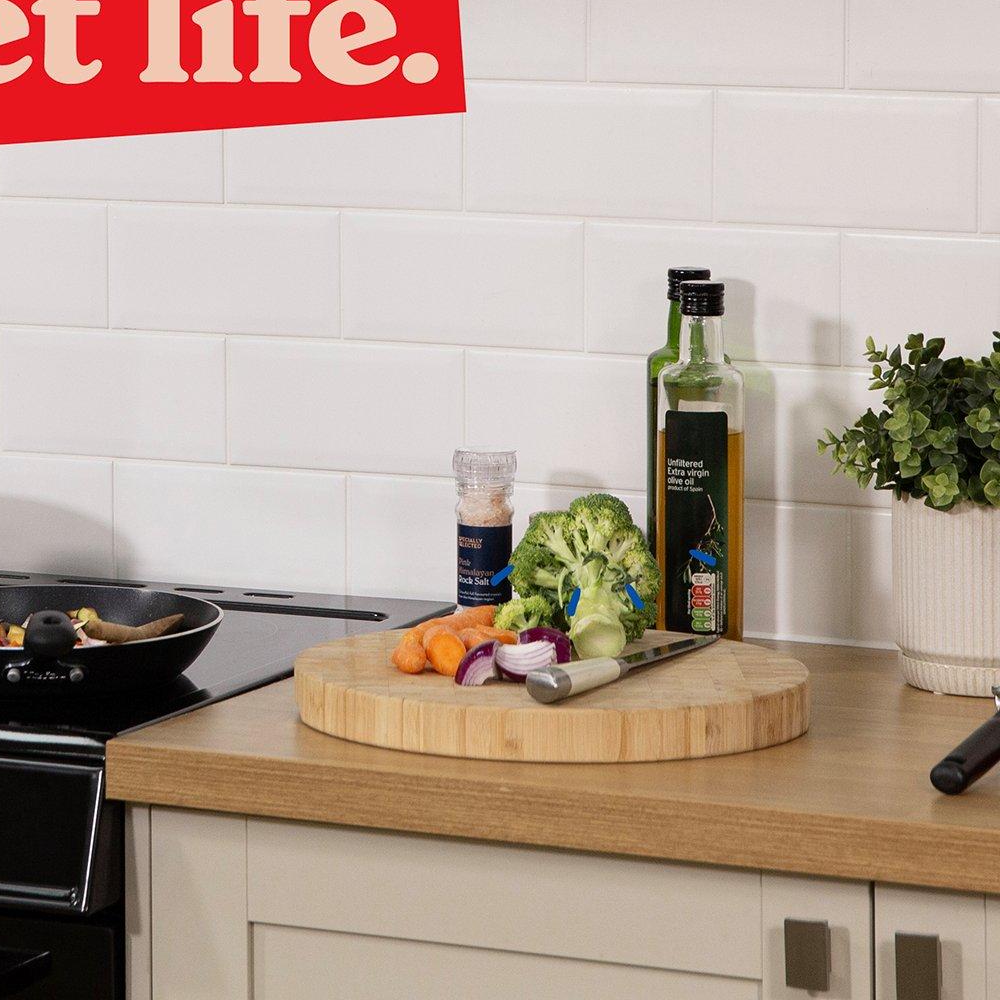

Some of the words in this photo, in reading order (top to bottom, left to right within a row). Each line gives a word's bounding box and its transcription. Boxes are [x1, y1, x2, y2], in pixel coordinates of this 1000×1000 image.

[667, 458, 704, 468] Unfiltered
[667, 467, 685, 476] Extra
[687, 469, 710, 479] virgin
[667, 477, 683, 485] olive
[684, 477, 695, 486] oil
[458, 574, 473, 585] Rock
[474, 576, 490, 586] Salt
